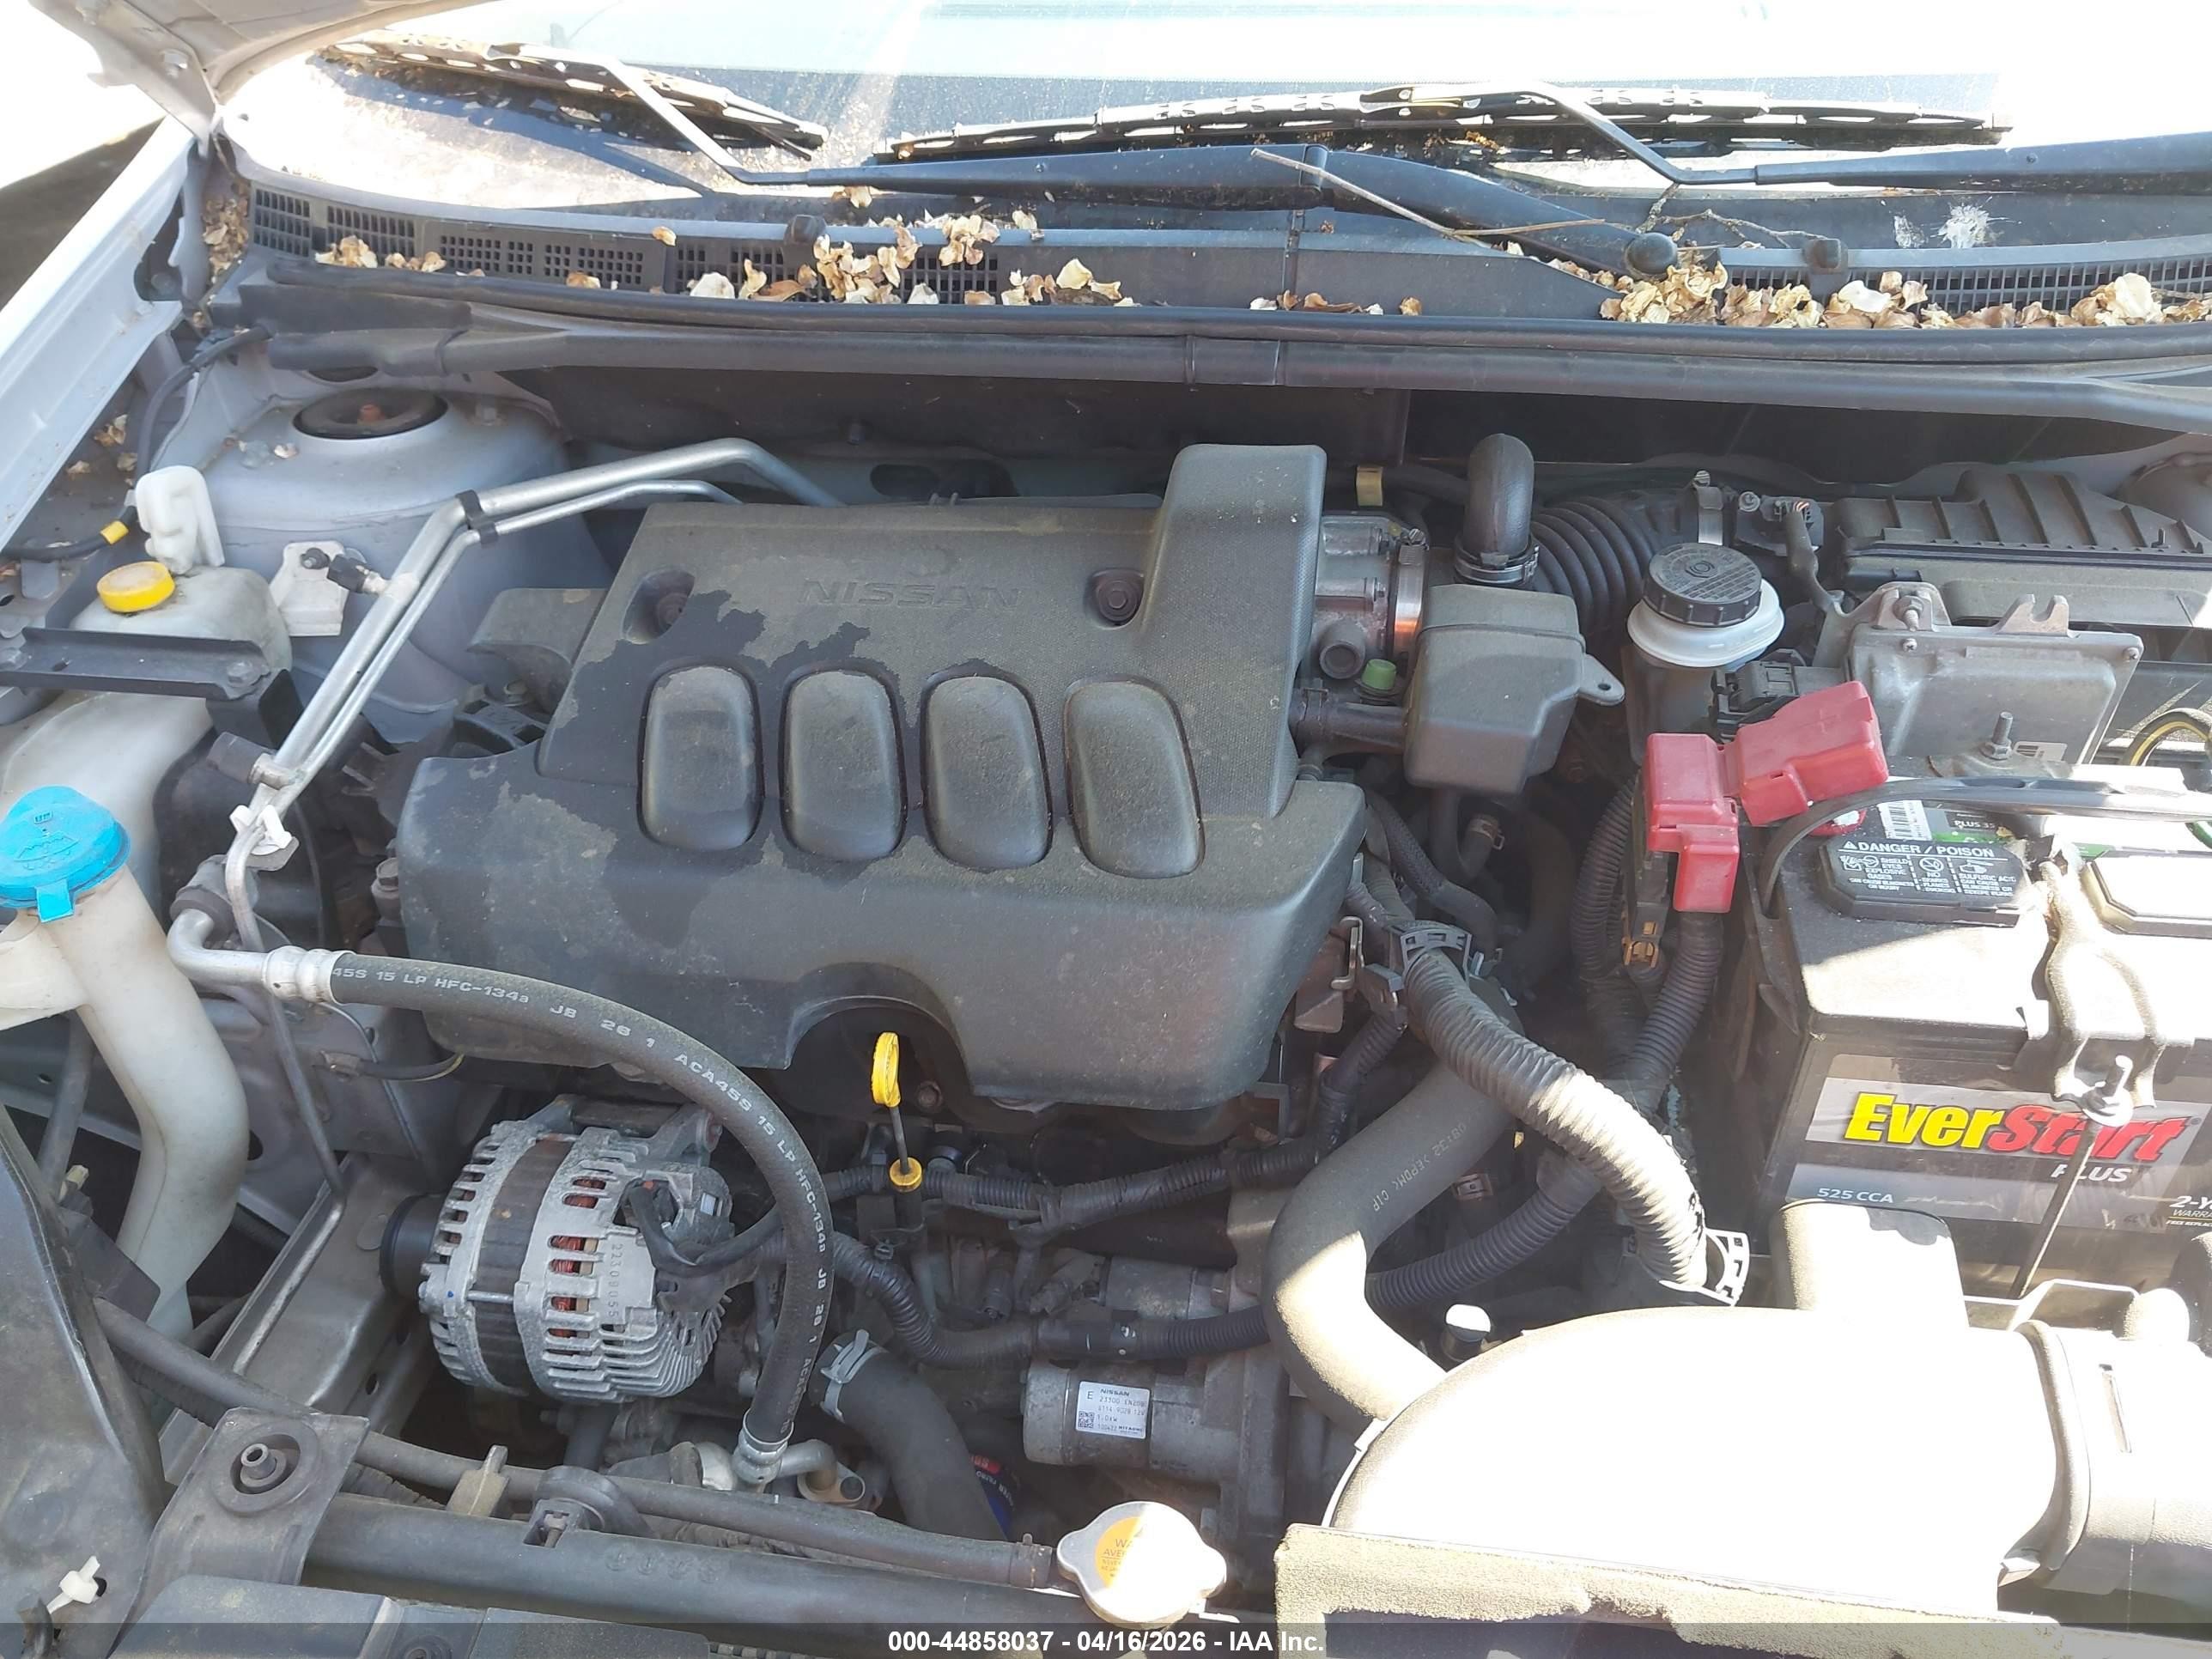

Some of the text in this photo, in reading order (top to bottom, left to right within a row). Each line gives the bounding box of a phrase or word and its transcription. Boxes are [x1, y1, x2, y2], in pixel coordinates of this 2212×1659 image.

[799, 579, 1021, 606] NISSAN
[1857, 842, 1995, 858] DANGER / POISON
[376, 970, 397, 981] 15
[403, 973, 428, 985] LP
[434, 977, 531, 1004] HFC-134a
[550, 1005, 577, 1019] JB
[673, 1053, 752, 1112] ACA45S
[757, 1115, 776, 1136] 15
[776, 1139, 797, 1163] LP
[1844, 1092, 2191, 1162] EverStart
[1817, 1188, 1893, 1203] 525 CCA
[2169, 1195, 2212, 1210] 2-Y
[1086, 1390, 1094, 1400] E
[1099, 1389, 1130, 1397] NISSAN
